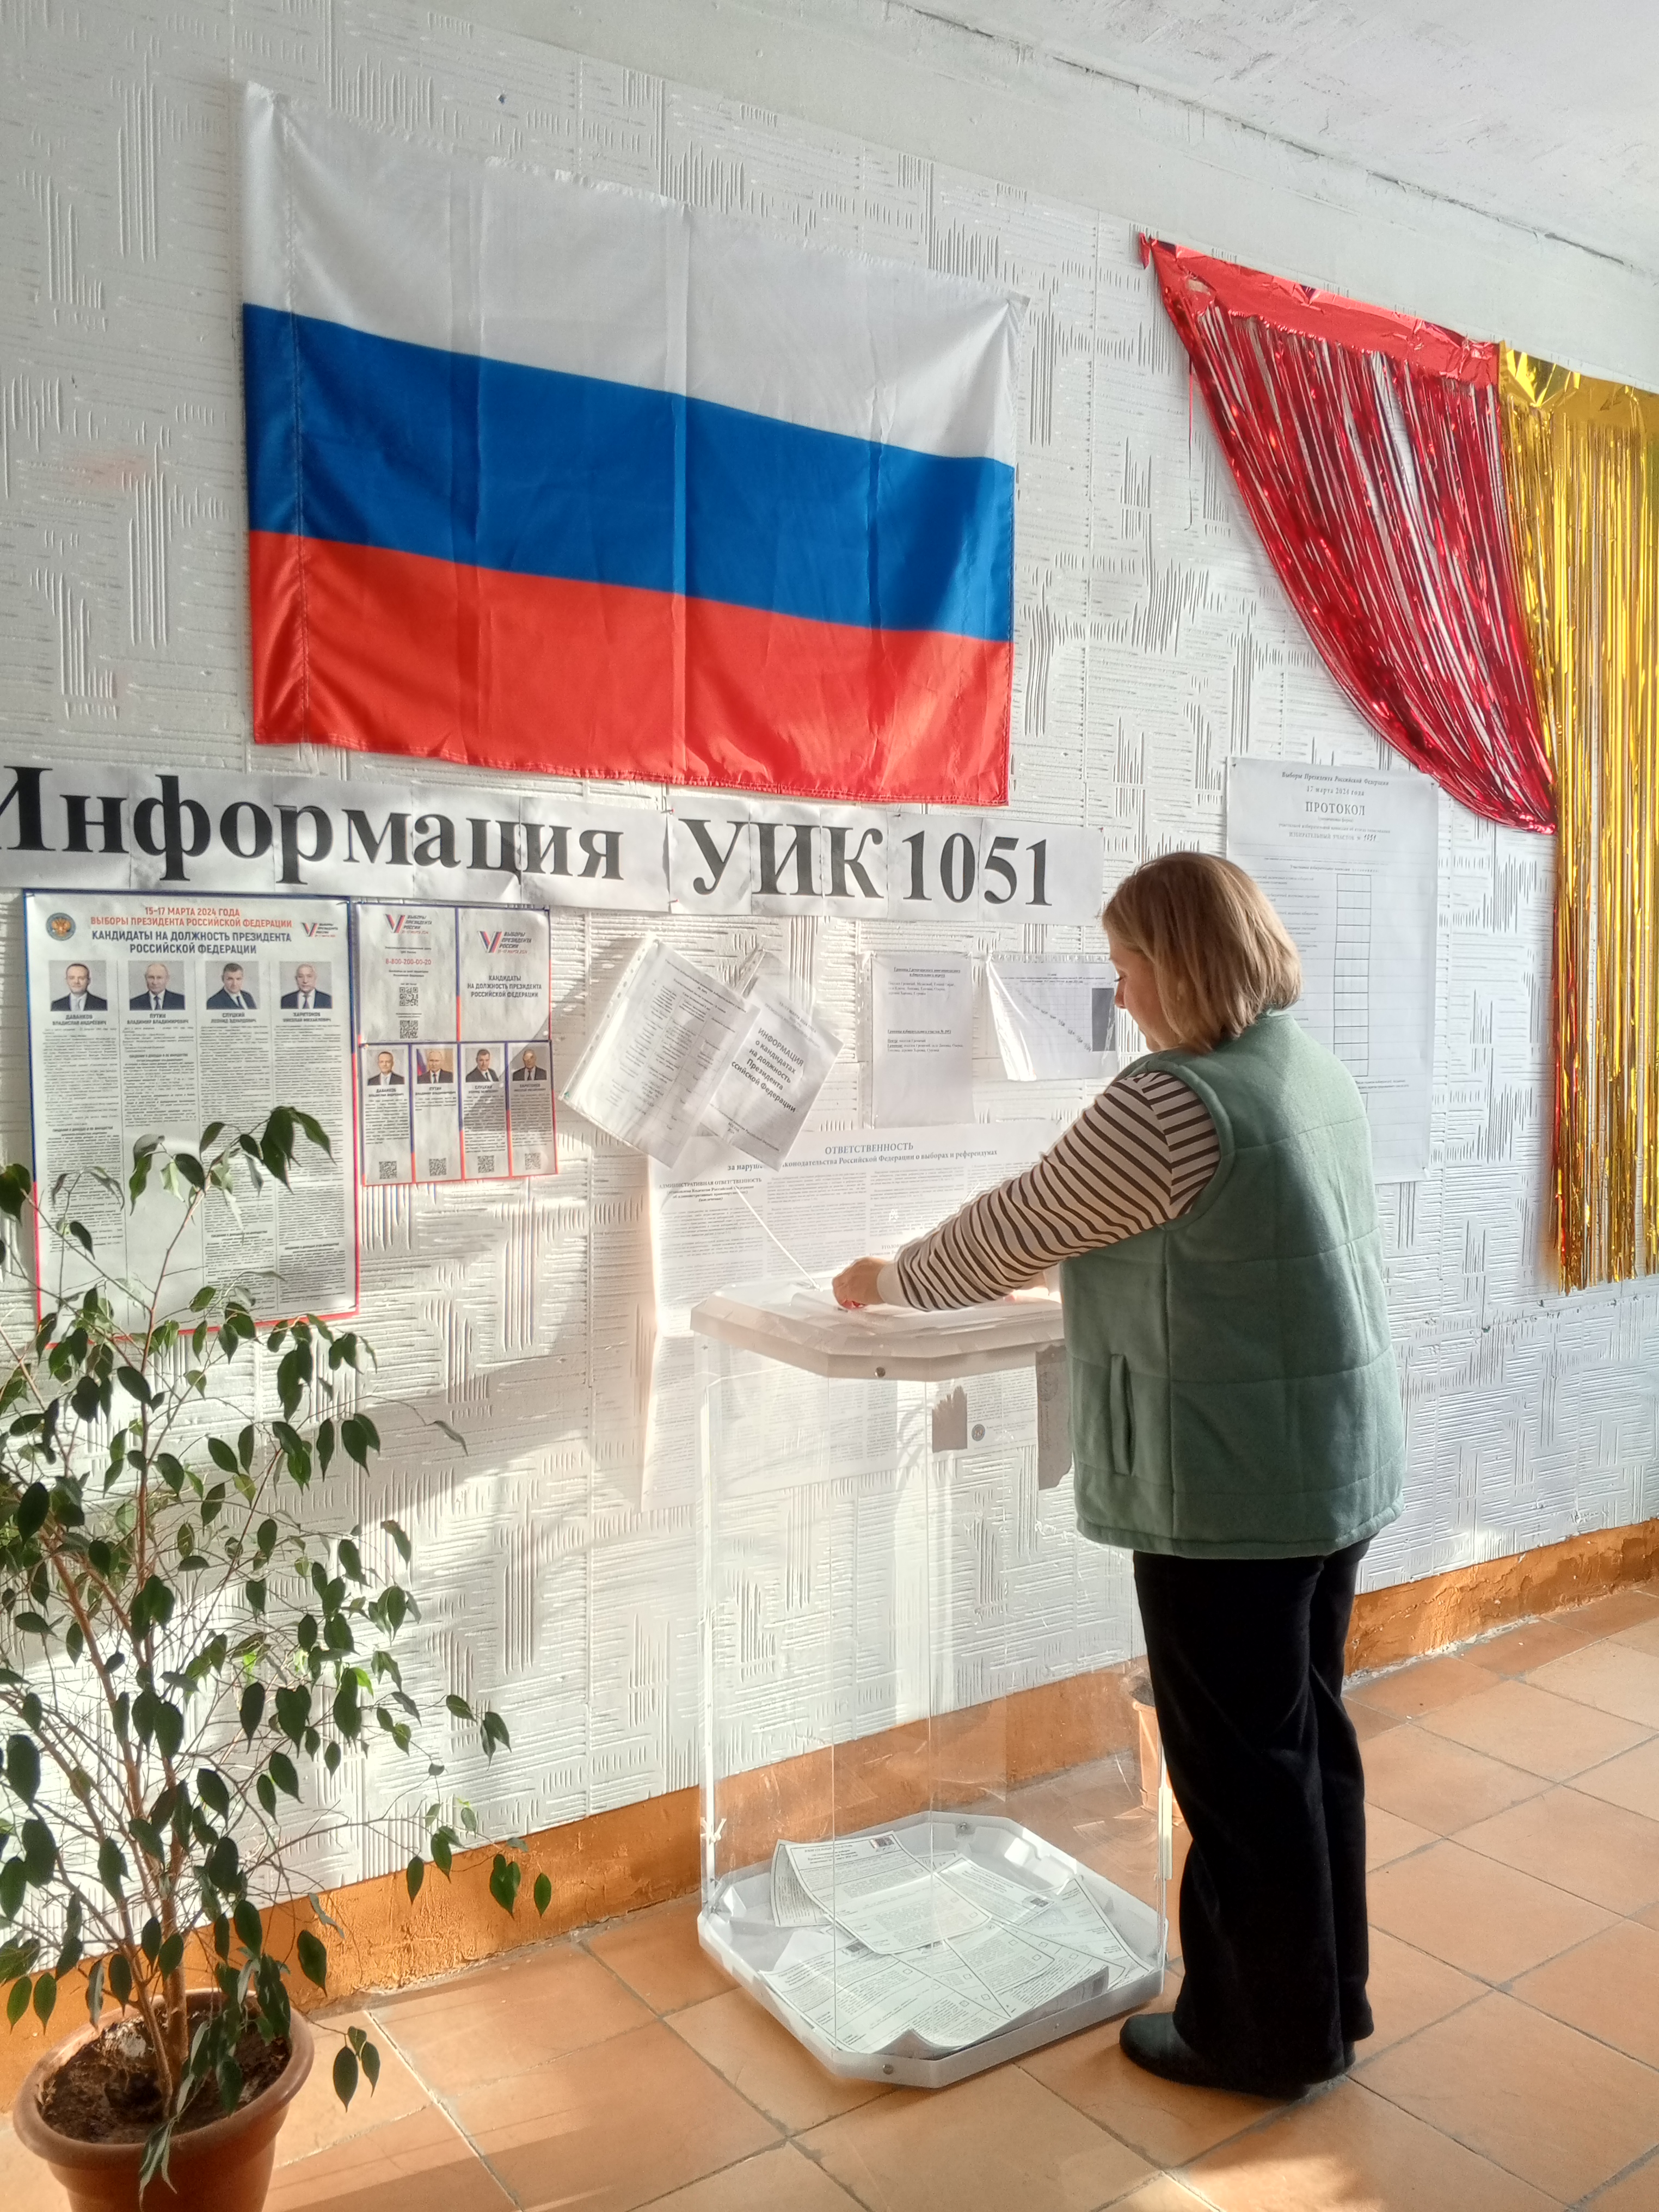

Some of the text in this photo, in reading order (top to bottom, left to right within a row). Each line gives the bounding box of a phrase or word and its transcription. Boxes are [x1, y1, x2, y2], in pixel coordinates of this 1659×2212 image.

[1282, 772, 1302, 780] Выборы
[1305, 801, 1365, 816] ПРОТОКОЛ
[0, 760, 1053, 906] Информация УИК 1051
[168, 907, 195, 915] МАРТА
[197, 908, 217, 916] 2024
[219, 908, 240, 917] ГОДА
[90, 917, 292, 929] ВЫБОРЫ ПРЕЗИДЕНТА РОССИЙСКОЙ ФЕДЕРАЦИИ
[92, 930, 292, 943] КАНДИДАТЫ НА ДОЛЖНОСТЬ ПРЕЗИДЕНТА
[130, 942, 257, 955] РОССИЙСКОЙ ФЕДЕРАЦИИ
[758, 1027, 804, 1067] ИНФОРМАЦИЯ
[749, 1048, 791, 1084] на должность
[760, 1043, 796, 1074] кандидатах
[746, 1058, 784, 1091] Президента
[732, 1061, 760, 1086] ссийской
[760, 1083, 796, 1113] Федерации
[825, 1142, 913, 1155] ОТВЕТСТВЕННОСТЬ
[839, 1156, 877, 1165] Российской
[878, 1154, 914, 1164] Федерации
[921, 1152, 949, 1160] выборах
[955, 1150, 998, 1160] референдумах
[659, 1181, 714, 1189] АДМИНИСТРАТИВНАЯ
